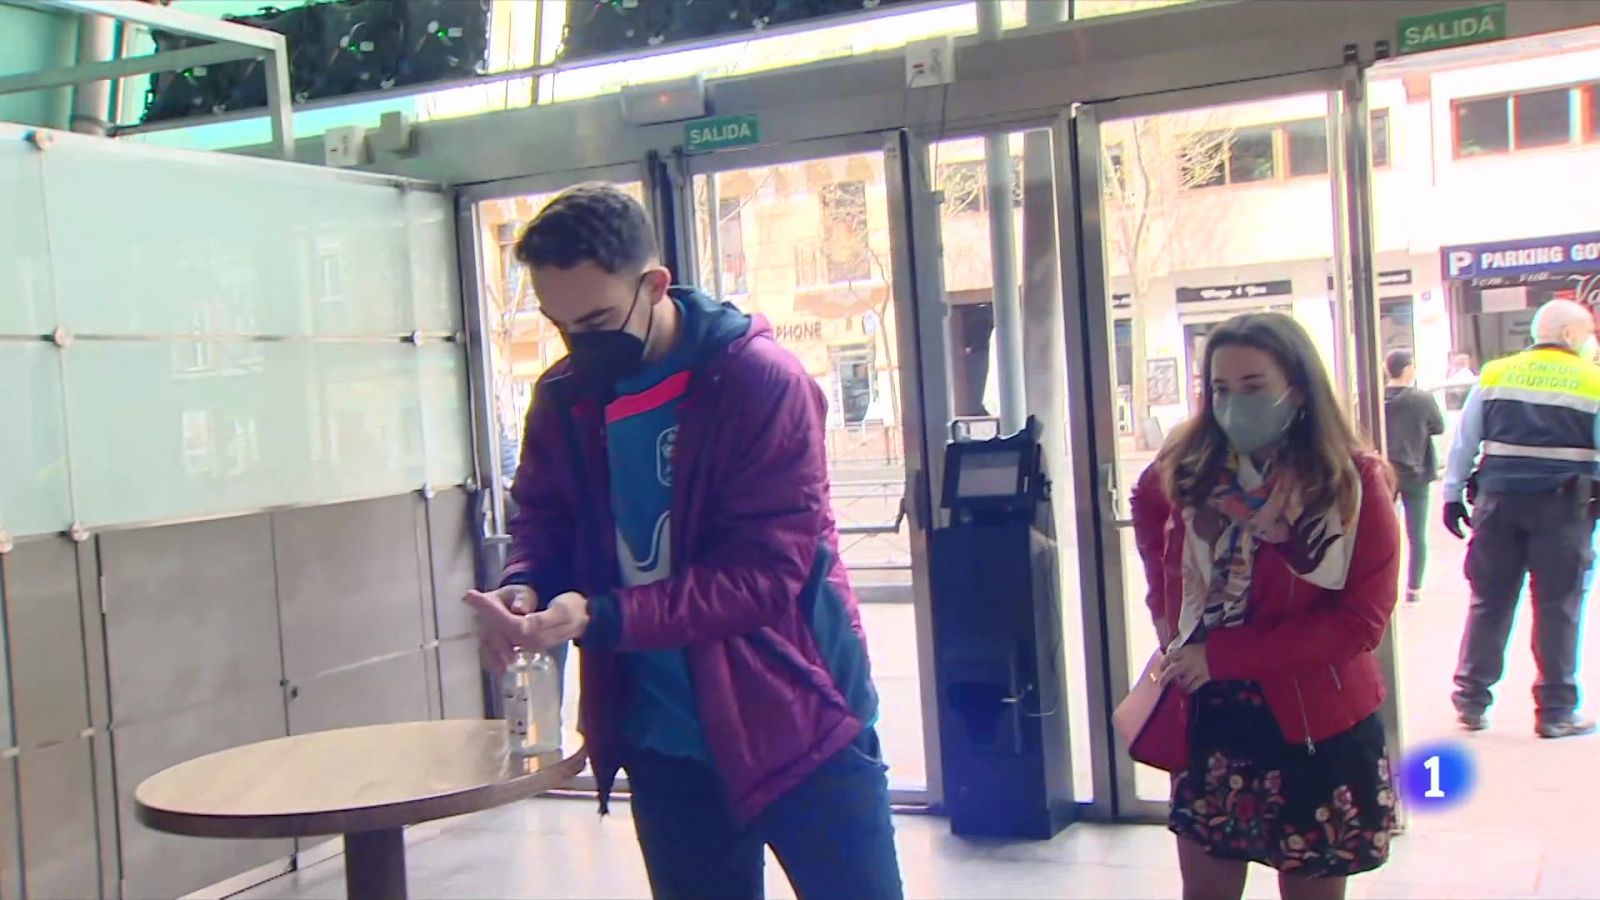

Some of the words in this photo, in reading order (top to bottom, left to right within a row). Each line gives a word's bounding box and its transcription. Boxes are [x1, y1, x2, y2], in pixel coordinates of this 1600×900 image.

[1404, 15, 1496, 46] SALIDA
[689, 122, 751, 144] SALIDA
[1449, 250, 1473, 276] P
[1481, 246, 1564, 269] PARKING
[1571, 242, 1600, 262] GO
